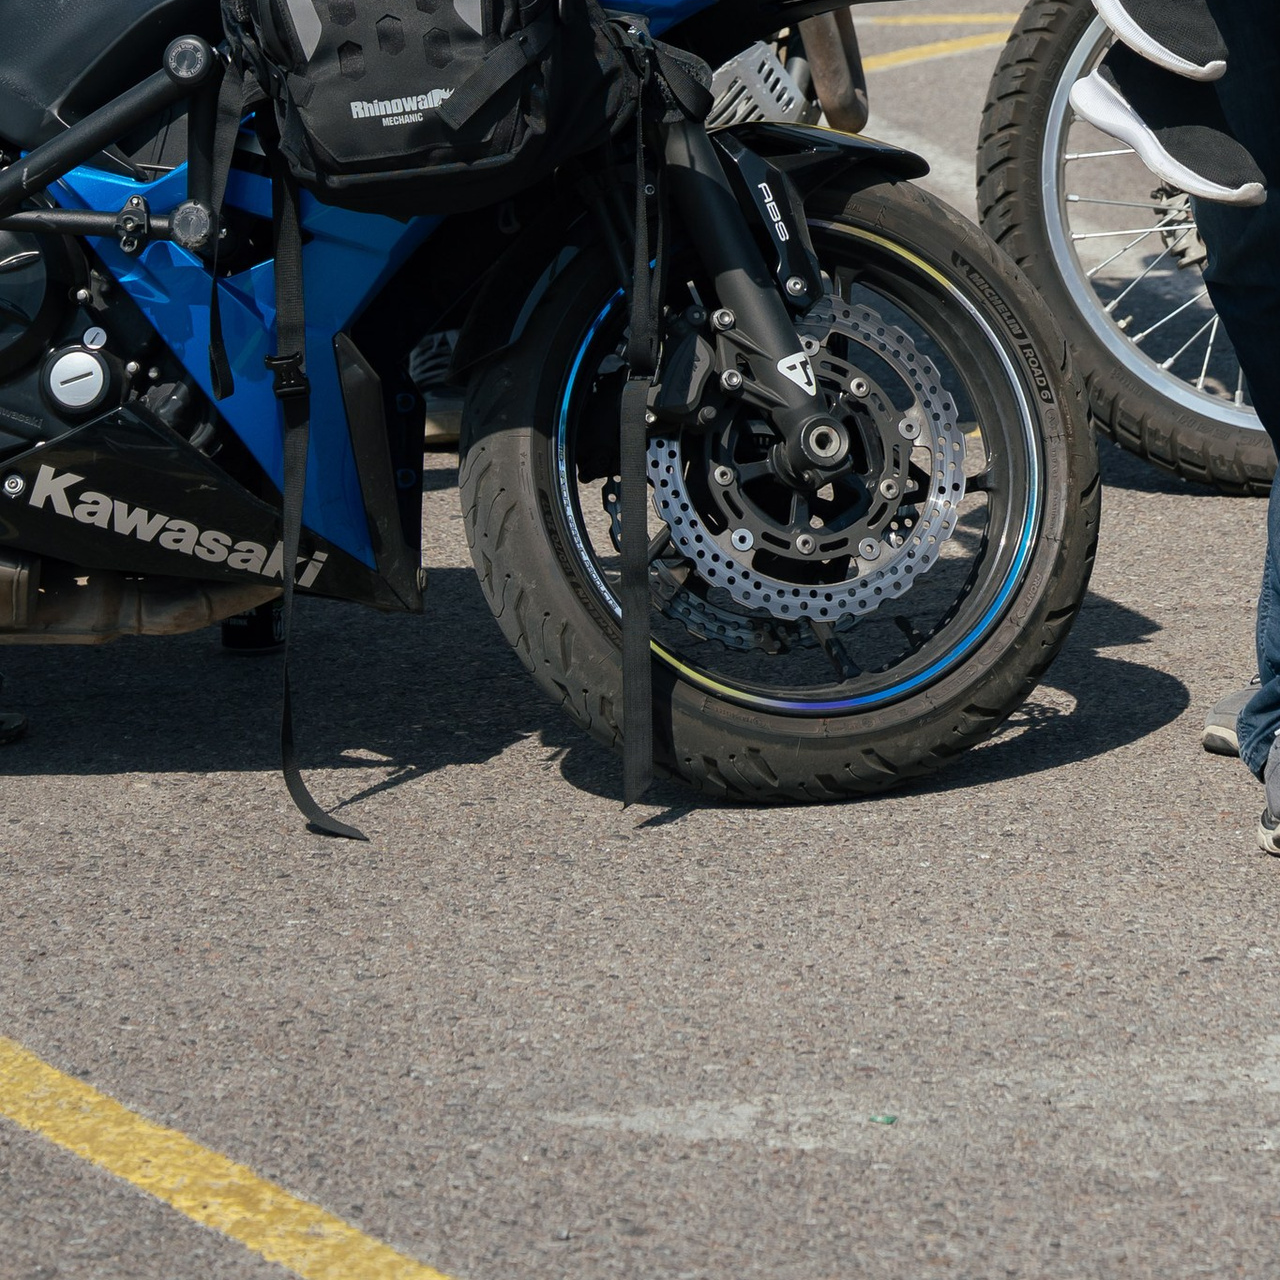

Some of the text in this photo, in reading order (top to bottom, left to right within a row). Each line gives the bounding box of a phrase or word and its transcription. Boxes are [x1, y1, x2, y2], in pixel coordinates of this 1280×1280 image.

[382, 113, 424, 127] MECHANIC
[757, 182, 789, 242] ABS
[969, 272, 1051, 401] MICHELIN ROAD 6
[0, 407, 44, 429] wasaki
